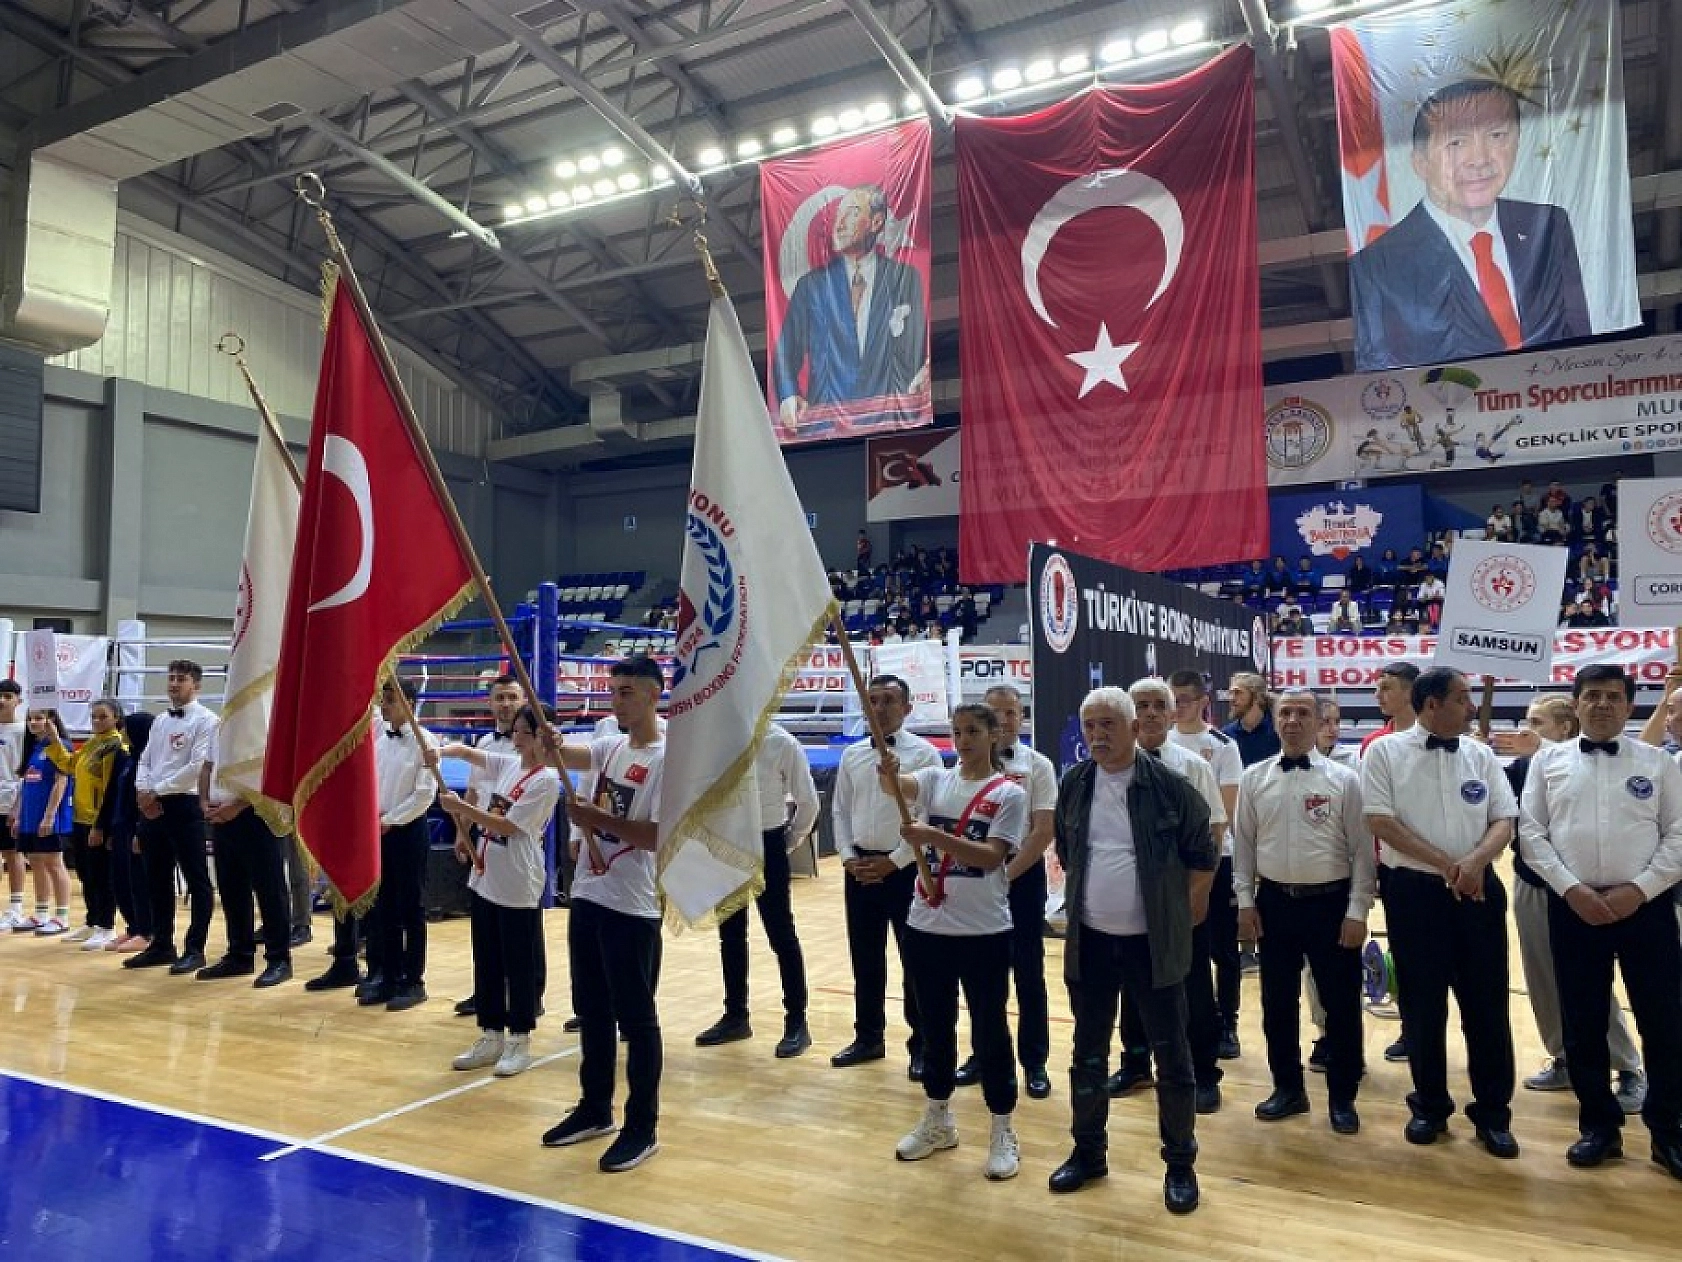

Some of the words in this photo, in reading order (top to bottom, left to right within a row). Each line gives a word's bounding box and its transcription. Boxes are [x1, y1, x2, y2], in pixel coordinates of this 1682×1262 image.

[1474, 389, 1522, 413] Tüm
[1516, 428, 1599, 449] GENÇLİK
[1605, 426, 1629, 440] VE
[691, 489, 735, 537] ONU
[1083, 583, 1155, 637] TÜRKİYE
[1159, 605, 1192, 646] BOKS
[1315, 639, 1406, 656] BOKS
[1457, 633, 1538, 655] SAMSUN
